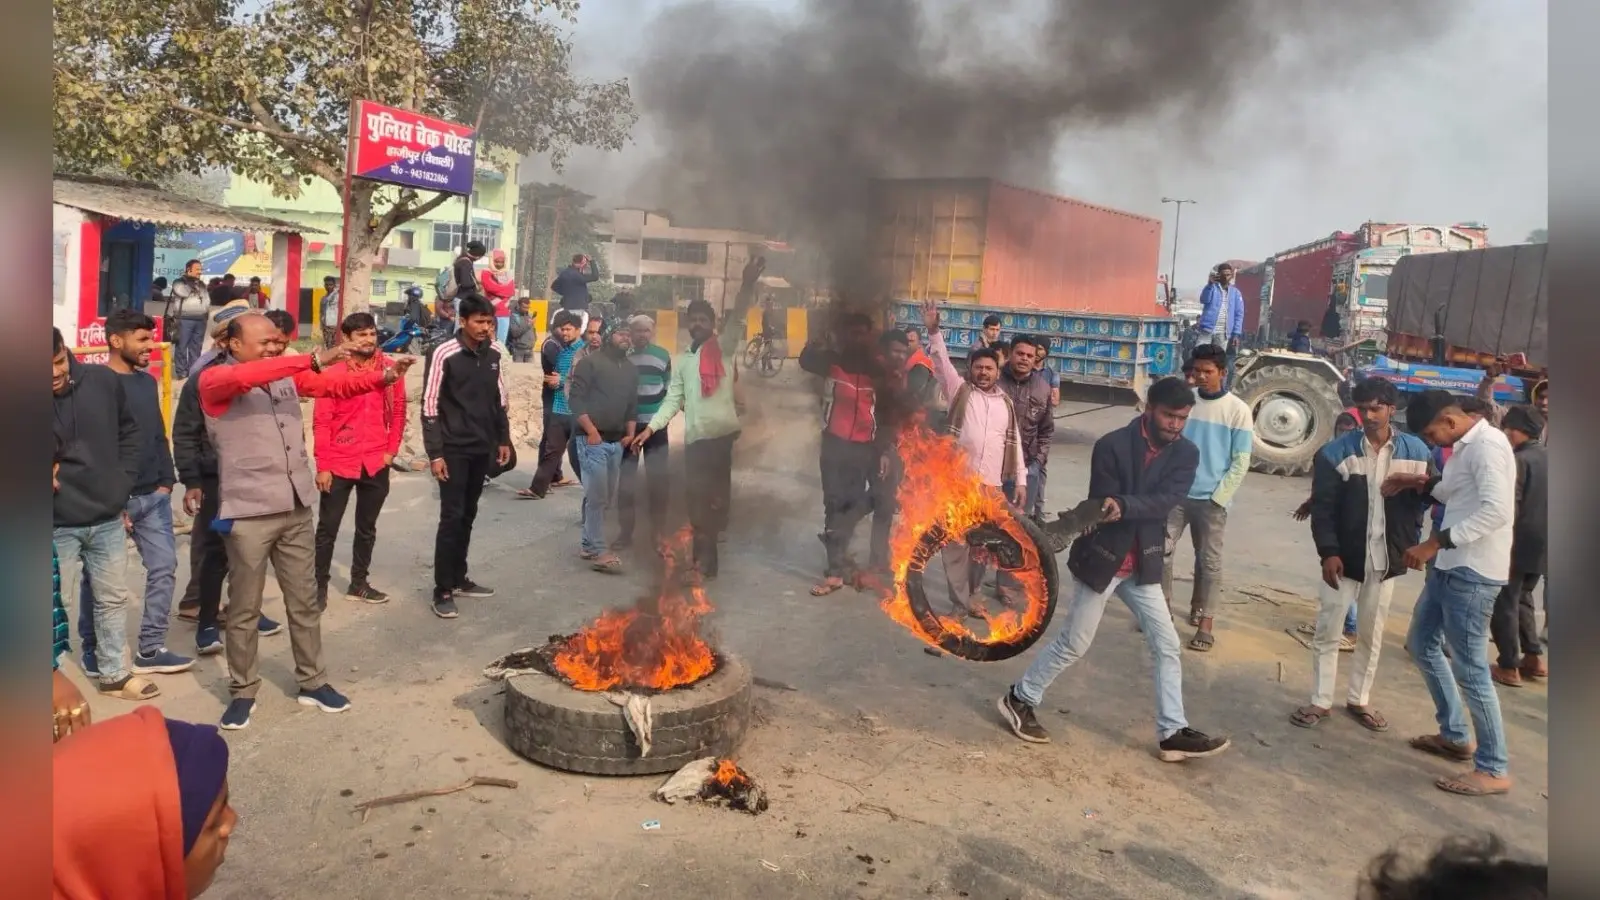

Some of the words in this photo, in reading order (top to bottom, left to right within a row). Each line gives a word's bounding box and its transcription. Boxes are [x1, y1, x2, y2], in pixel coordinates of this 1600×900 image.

[366, 112, 413, 141] पुलिस
[415, 121, 442, 148] चेक
[443, 130, 473, 155] पोस्ट
[386, 146, 420, 164] हाजीपुर
[421, 151, 454, 171] (वैशाली)
